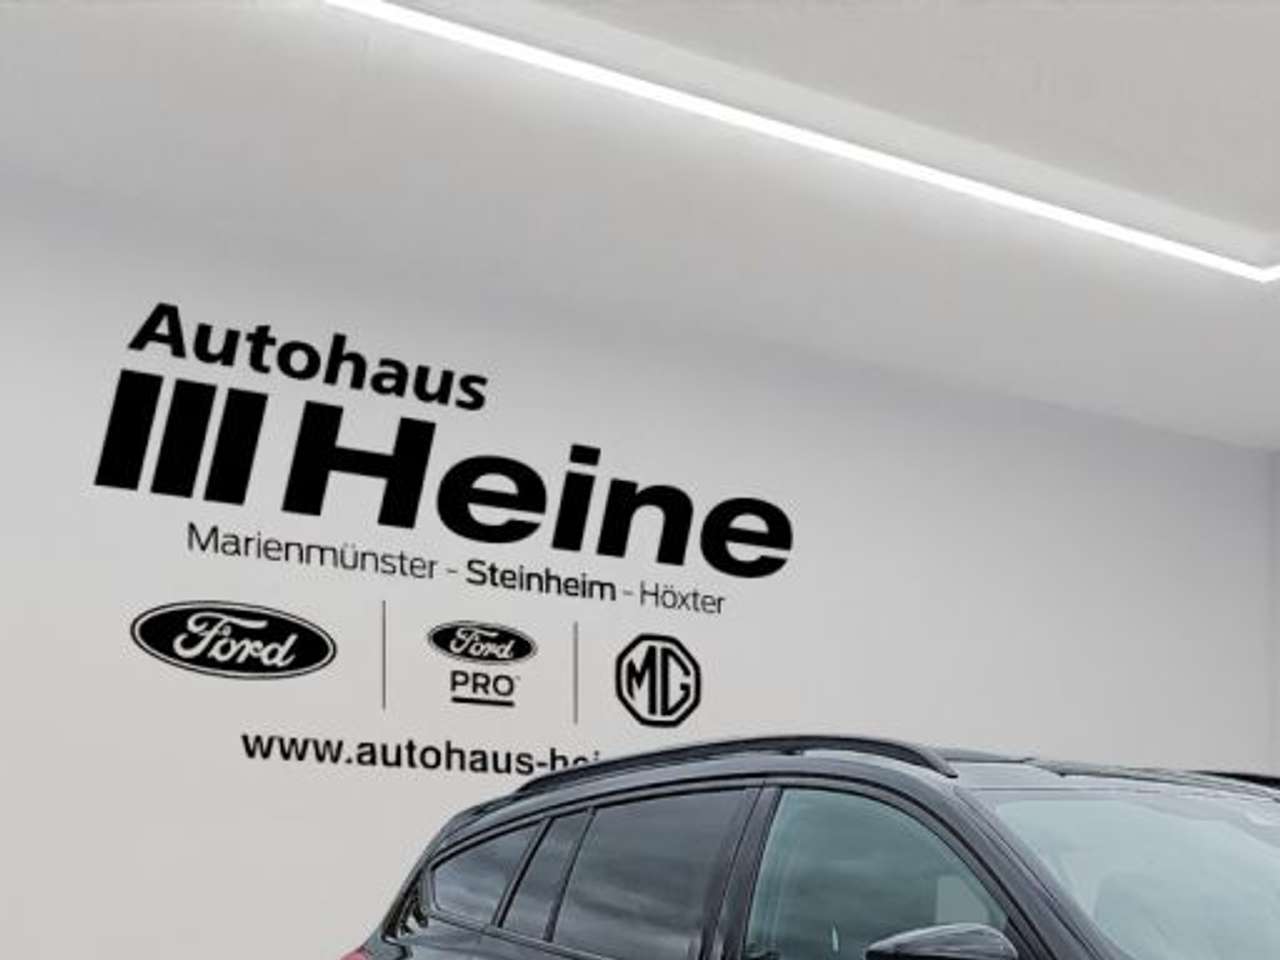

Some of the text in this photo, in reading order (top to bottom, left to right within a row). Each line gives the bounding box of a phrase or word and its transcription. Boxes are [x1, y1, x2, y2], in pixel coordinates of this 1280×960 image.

[127, 302, 488, 412] Autohaus
[281, 400, 794, 579] Heine
[187, 521, 438, 580] Marienmünster
[466, 559, 617, 601] Steinheim
[640, 583, 726, 615] Höxter
[172, 610, 297, 670] Ford
[449, 625, 517, 659] Ford
[450, 670, 515, 697] PRO
[625, 644, 692, 717] MG
[241, 734, 600, 776] www.autohaus-h
